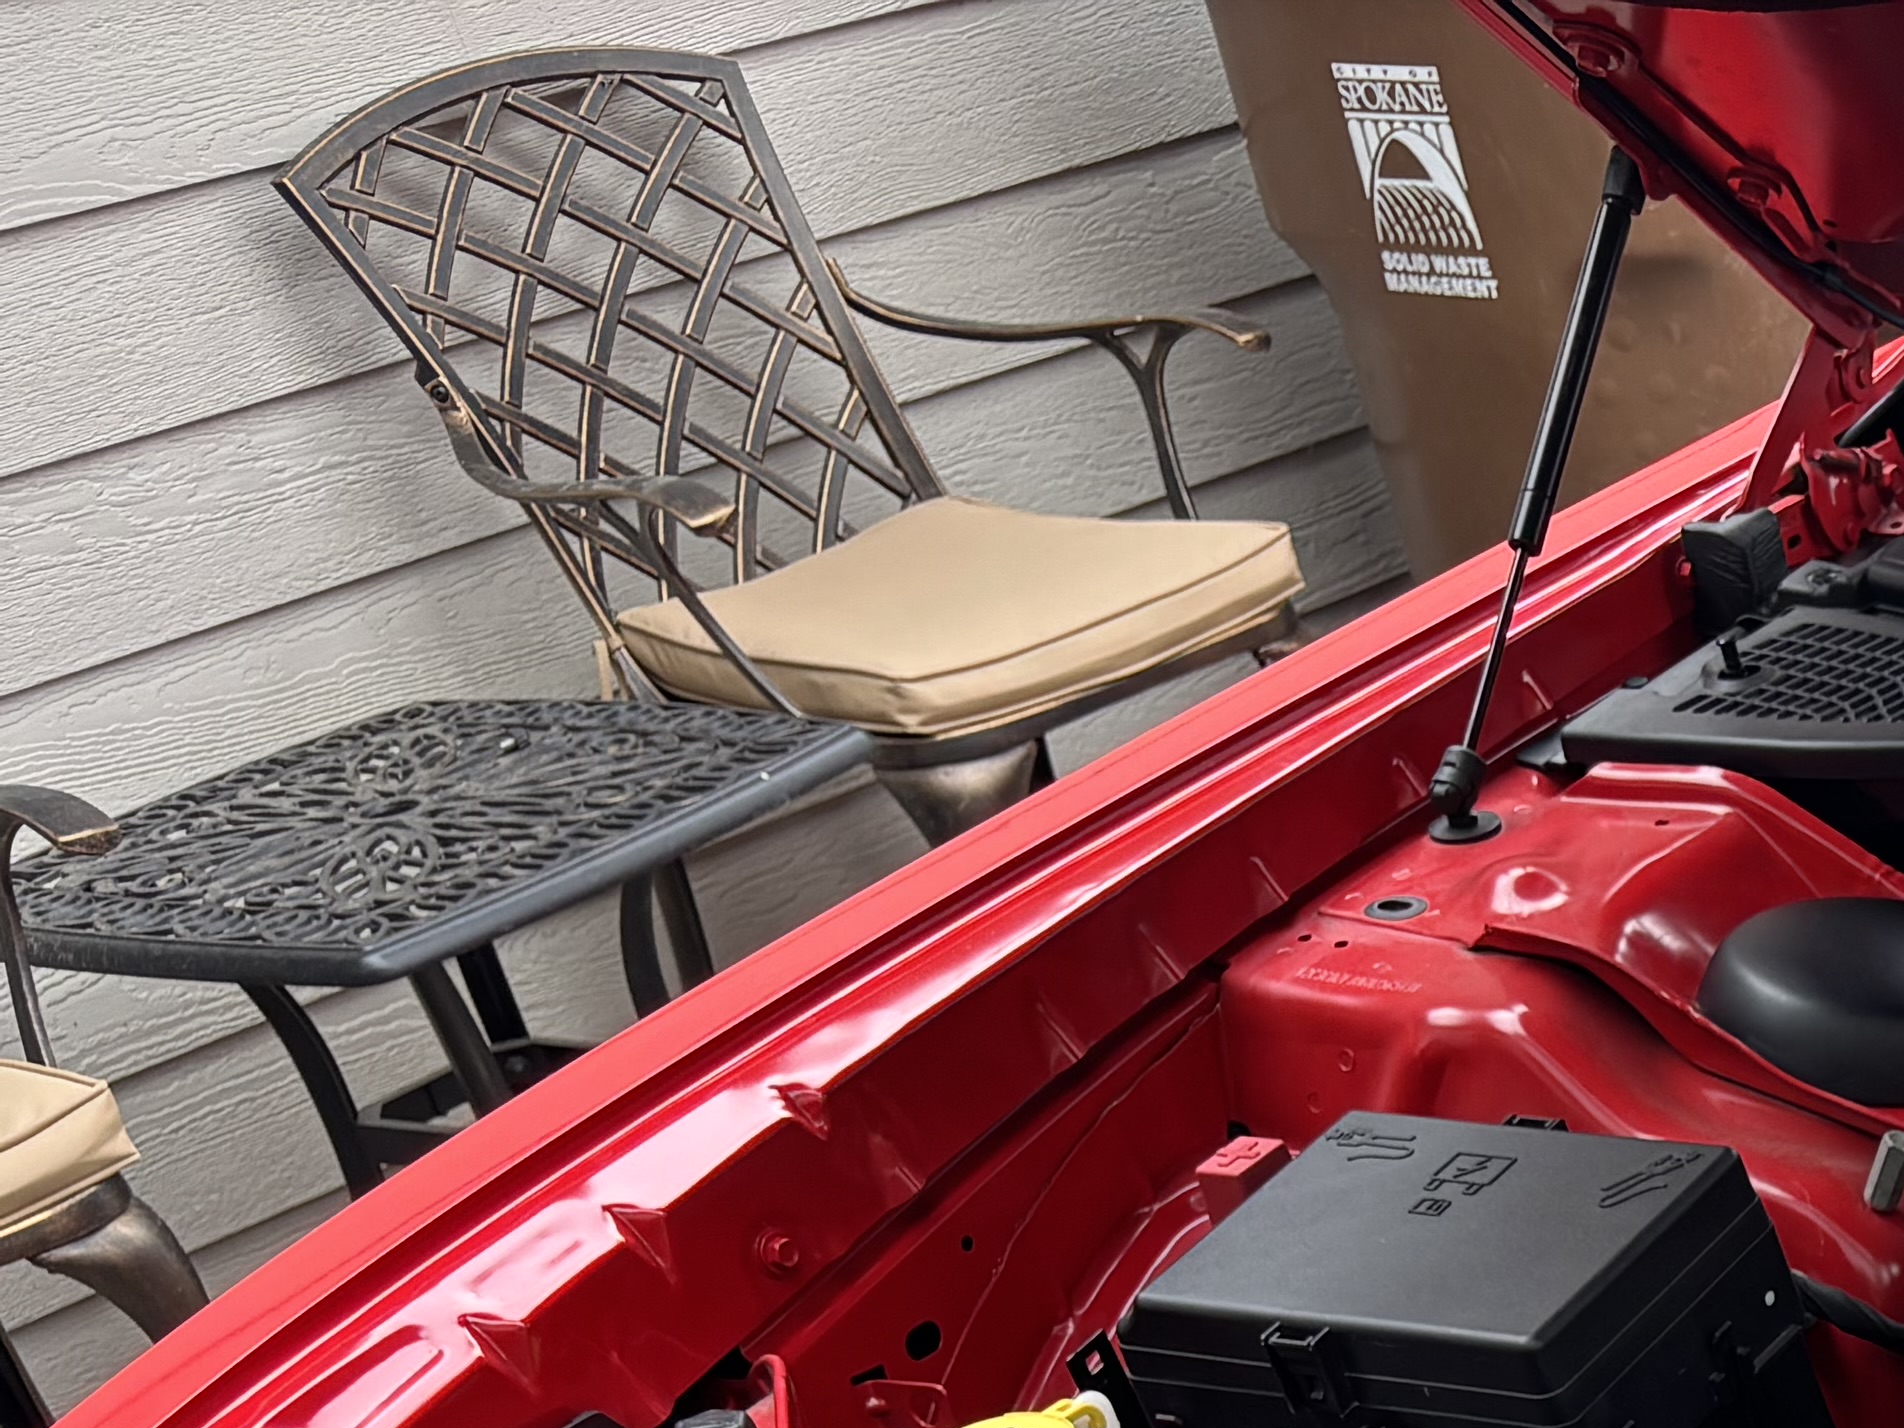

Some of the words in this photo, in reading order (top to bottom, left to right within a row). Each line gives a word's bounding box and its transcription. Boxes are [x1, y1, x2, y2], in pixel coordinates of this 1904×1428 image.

[1337, 80, 1448, 113] SPOKANE
[1381, 250, 1430, 273] SOLID
[1430, 254, 1492, 277] WASTE
[1383, 271, 1498, 299] MANAGEMENT
